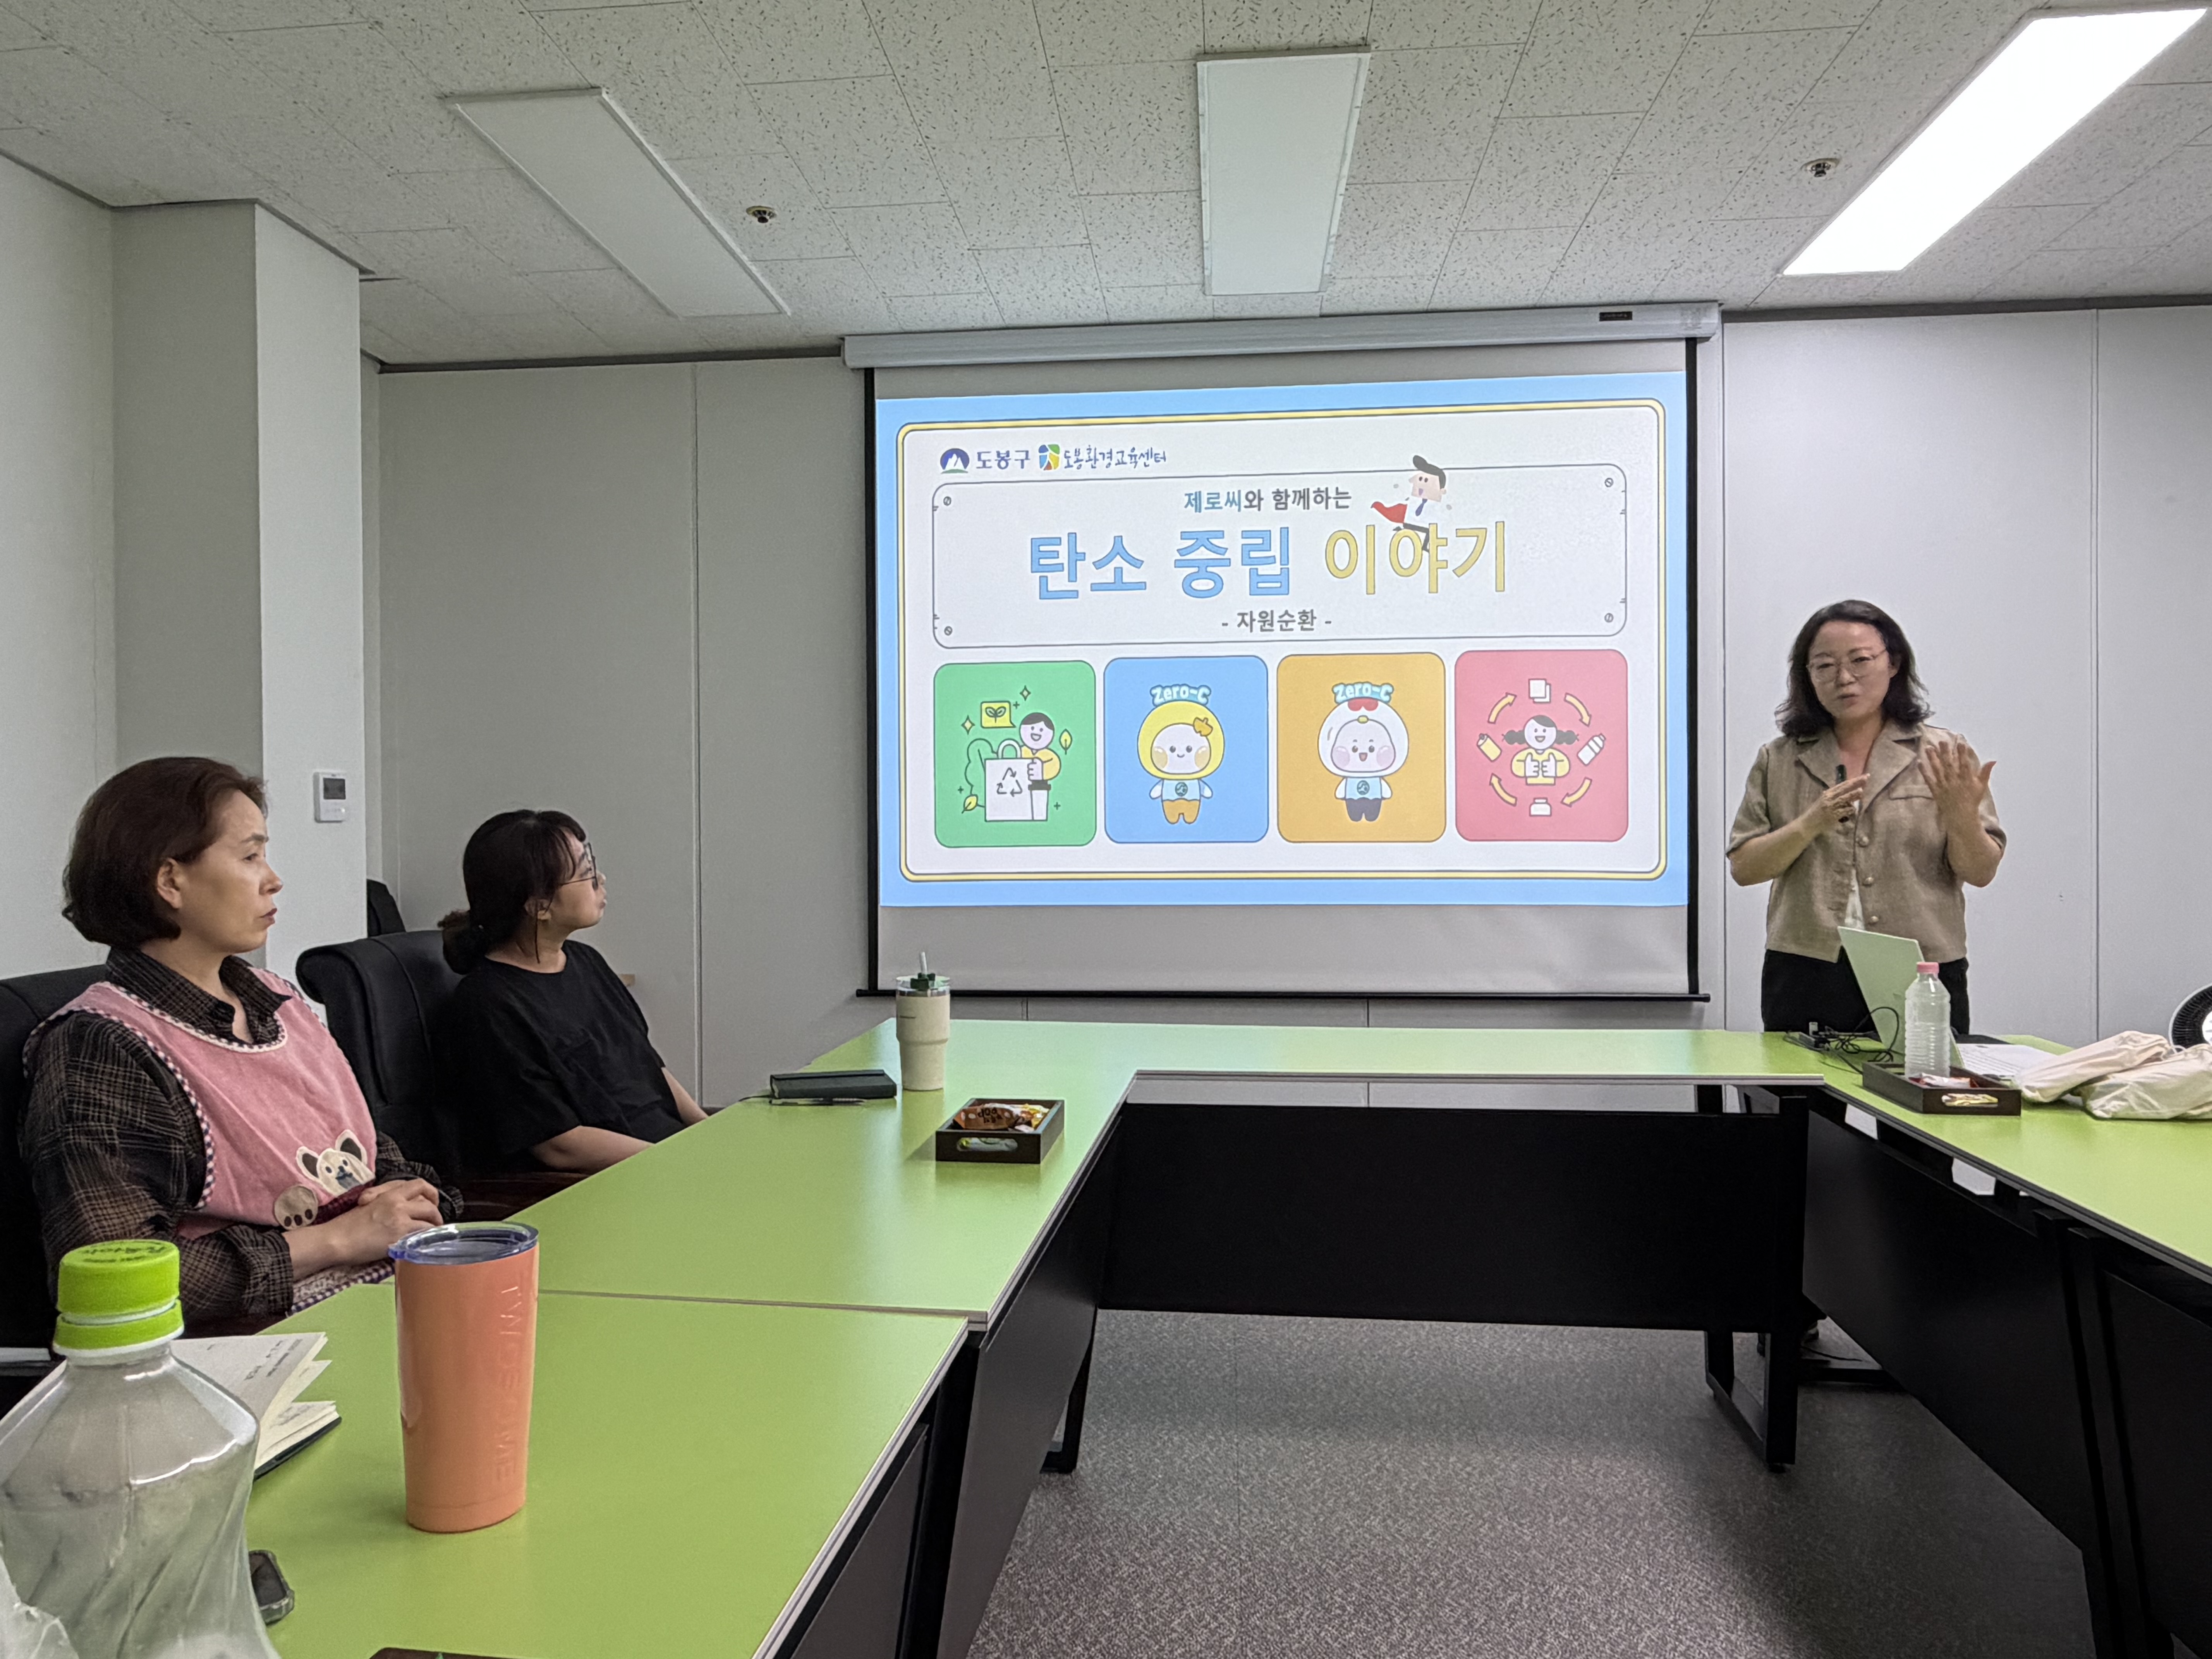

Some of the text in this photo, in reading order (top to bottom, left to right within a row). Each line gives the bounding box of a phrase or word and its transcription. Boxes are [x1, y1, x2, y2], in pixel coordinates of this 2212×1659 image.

[976, 449, 1030, 470] 도봉구
[1064, 444, 1167, 471] 도봉환경교육센터
[1184, 486, 1352, 513] 제로씨와 함께하는
[1030, 520, 1505, 599] 탄소 중립 이야기
[1237, 609, 1317, 633] 자원순환
